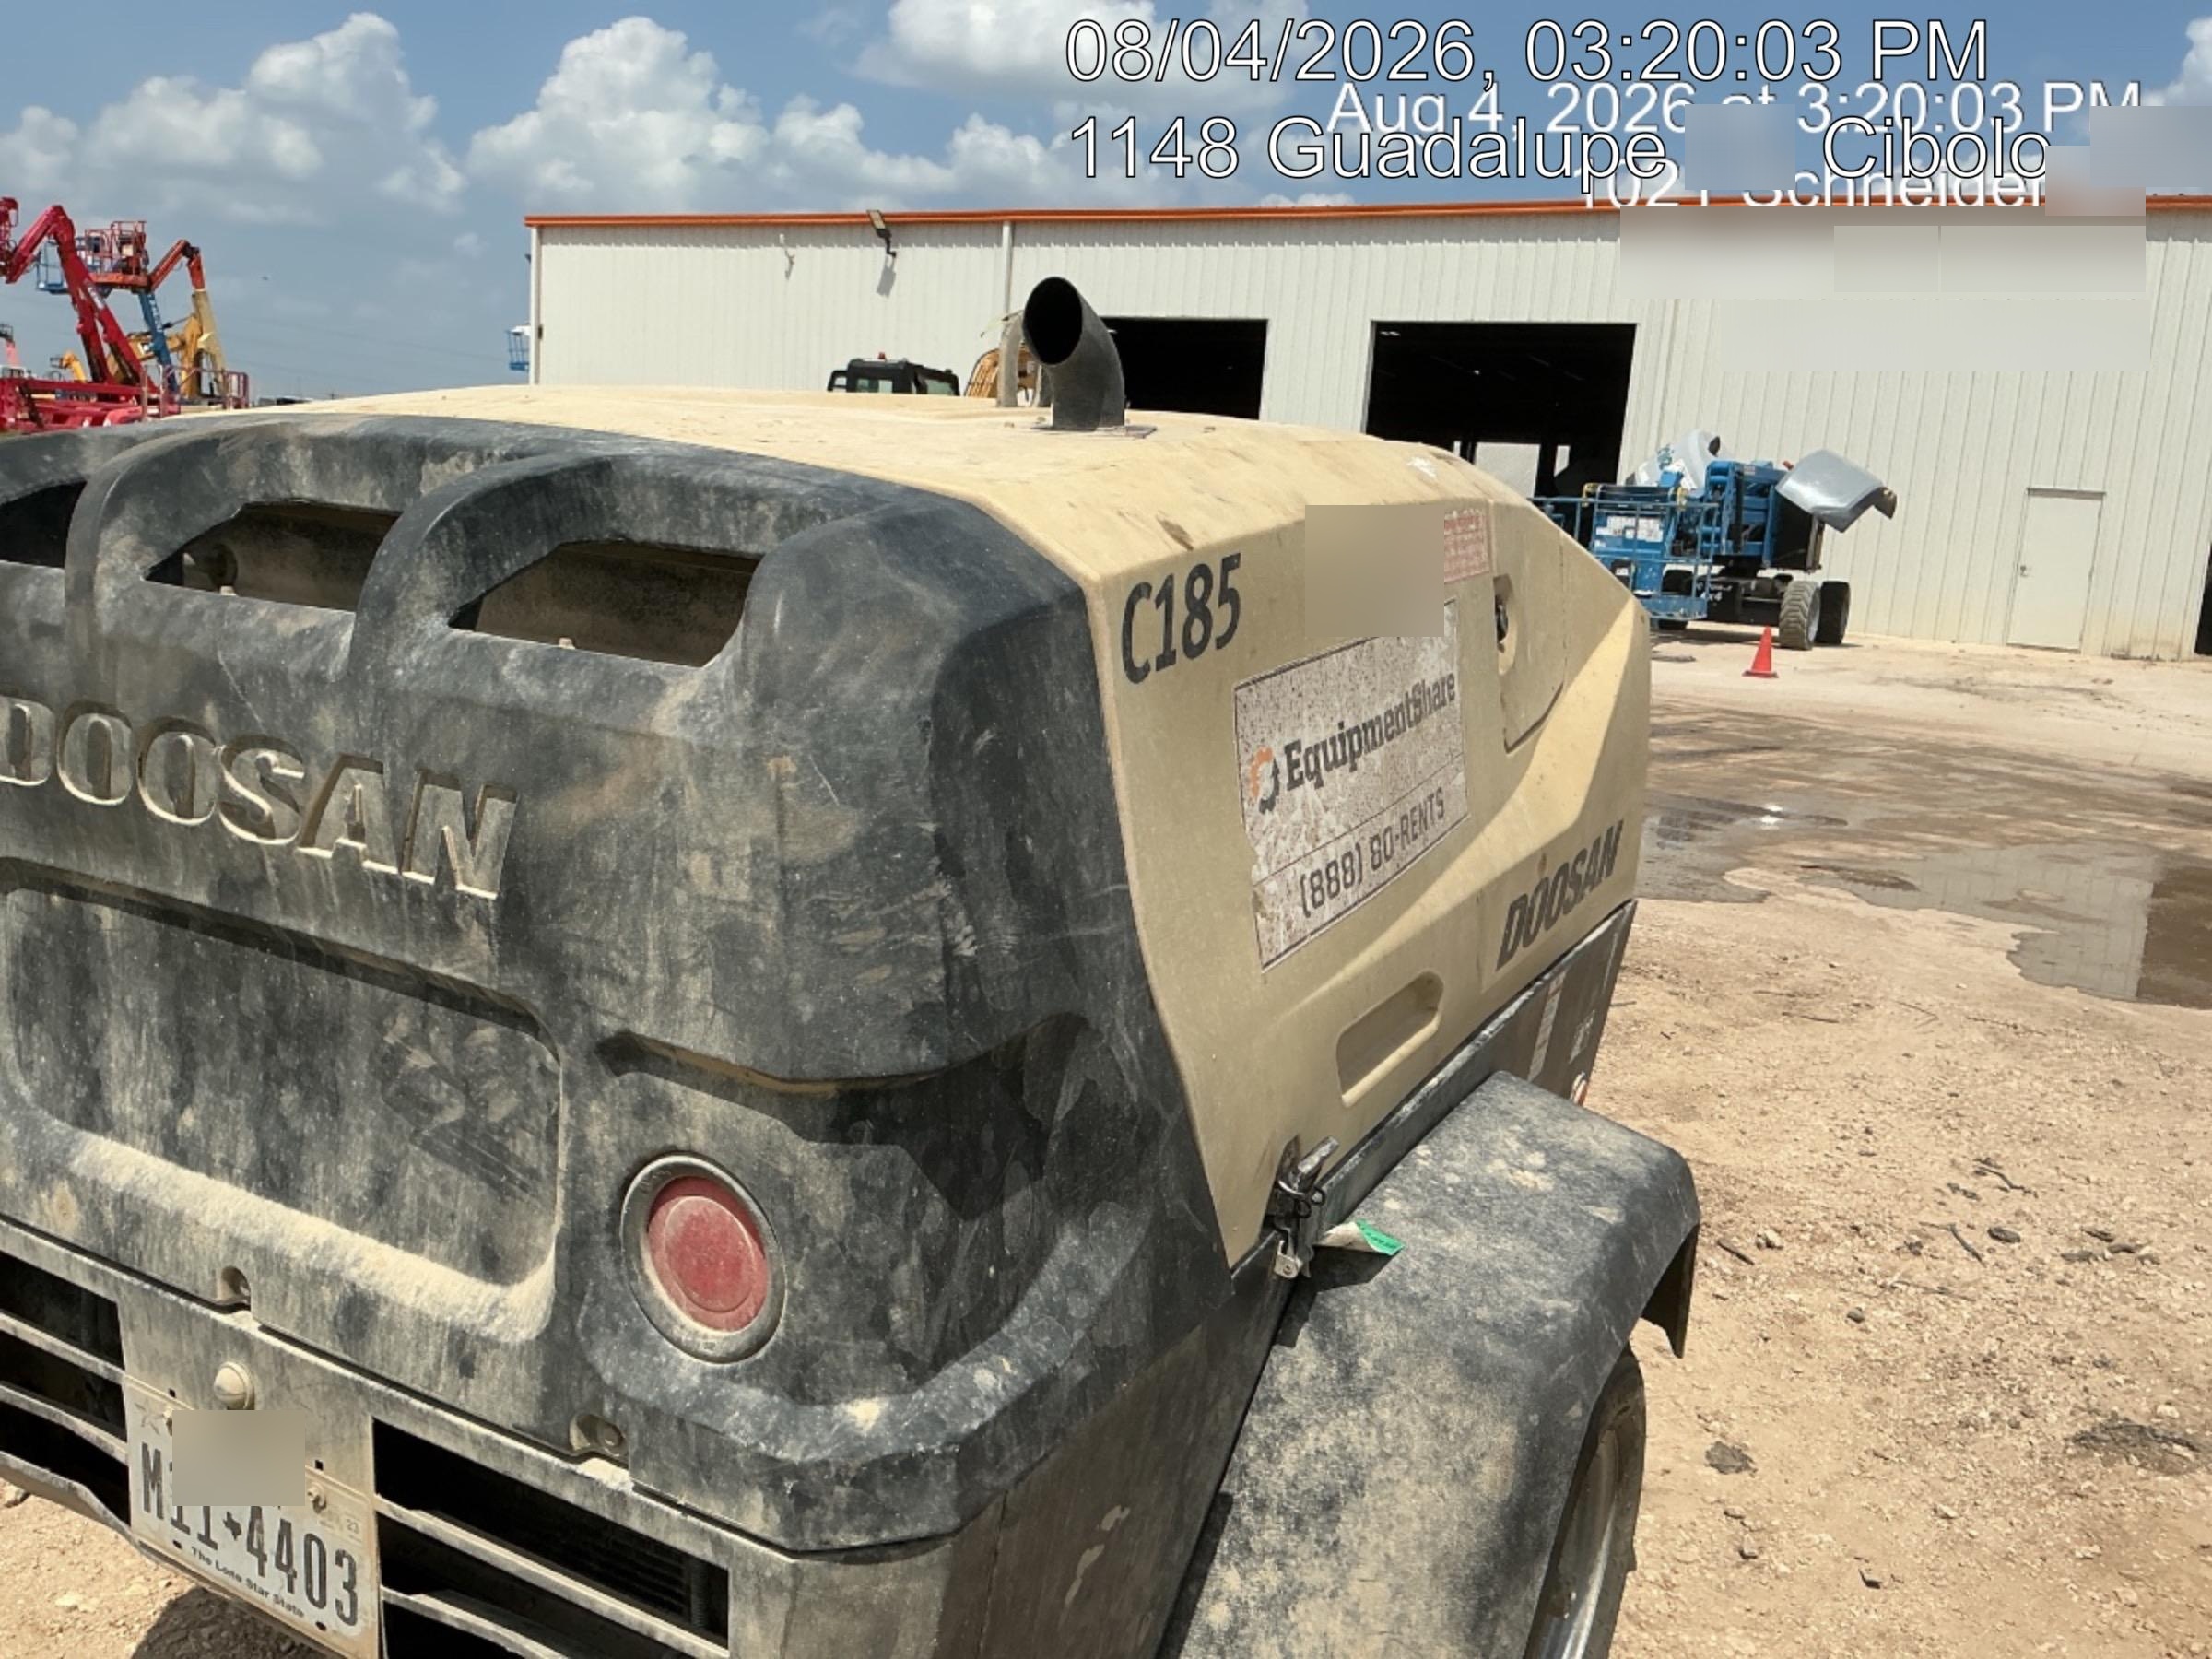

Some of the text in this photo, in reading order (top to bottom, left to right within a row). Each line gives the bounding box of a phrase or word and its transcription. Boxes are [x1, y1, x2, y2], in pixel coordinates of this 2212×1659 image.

[1121, 552, 1241, 684] C185
[1284, 672, 1456, 791] EquipmentShare
[1300, 786, 1446, 919] (888) 80-RENTS
[1495, 819, 1625, 971] DOOSAN
